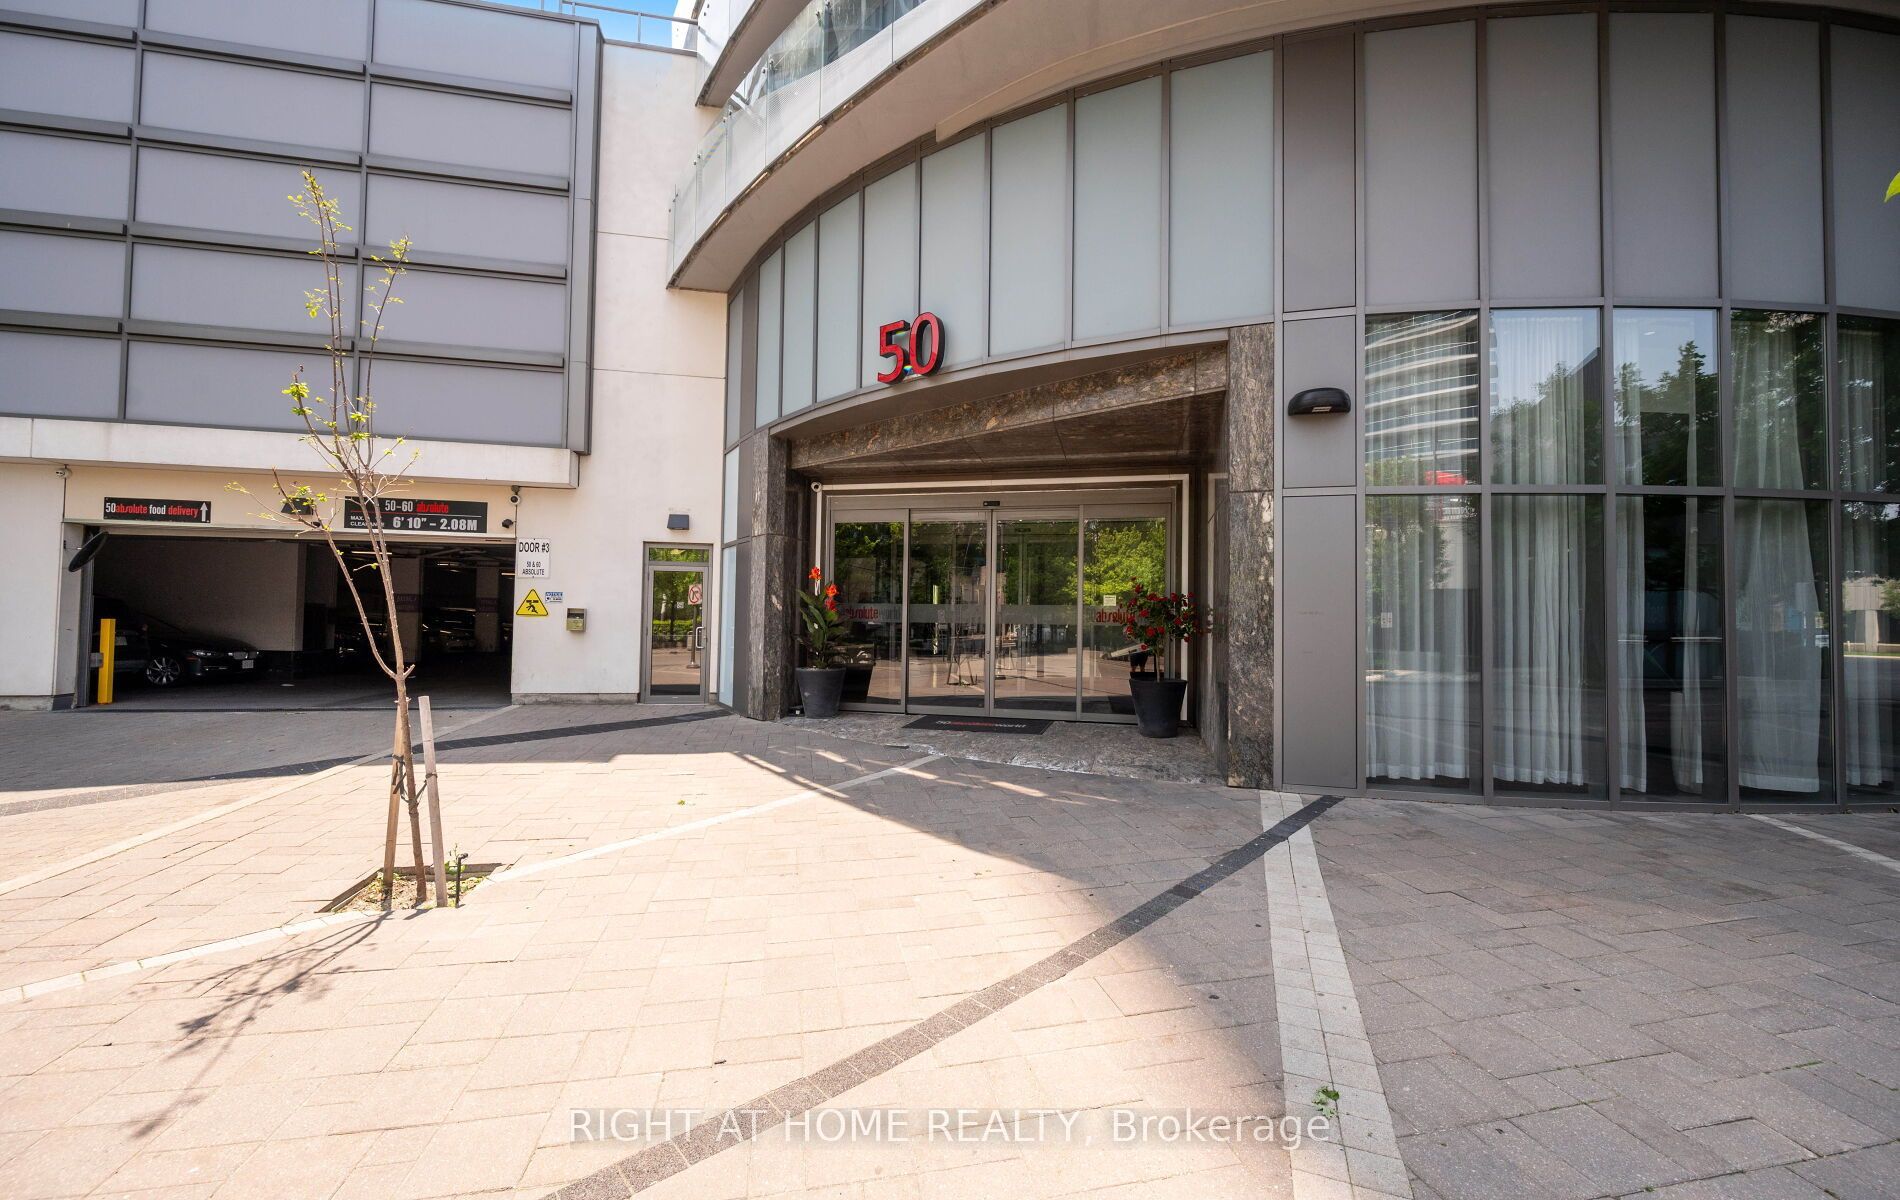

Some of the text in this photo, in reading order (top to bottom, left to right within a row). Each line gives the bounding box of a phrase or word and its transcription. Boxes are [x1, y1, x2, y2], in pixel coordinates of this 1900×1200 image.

[878, 312, 945, 385] 50
[149, 504, 166, 515] food
[168, 505, 199, 518] delivery
[385, 500, 449, 514] 50-60 absolute
[439, 518, 478, 531] 2.08M
[519, 542, 550, 553] DOOR #3
[522, 568, 545, 576] ABSOLUTE
